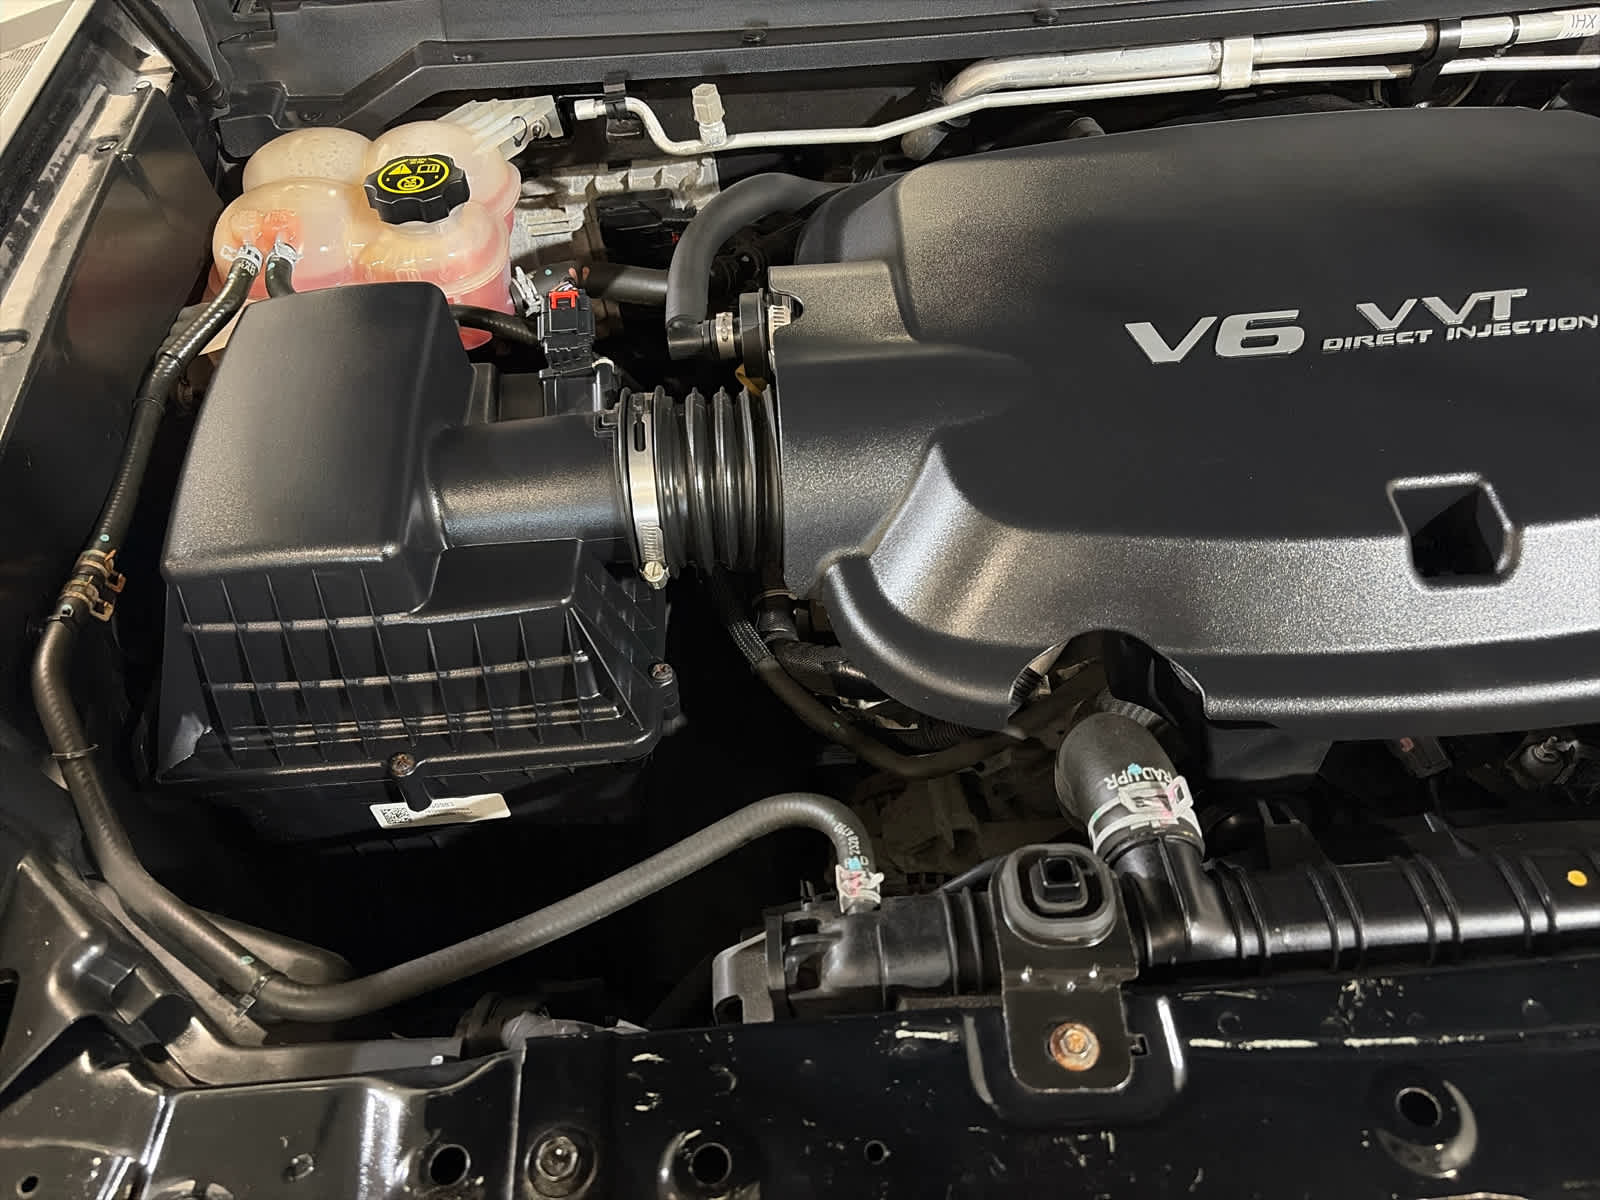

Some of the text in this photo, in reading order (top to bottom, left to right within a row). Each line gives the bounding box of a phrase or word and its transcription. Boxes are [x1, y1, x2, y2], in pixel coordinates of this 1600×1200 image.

[1356, 288, 1528, 331] VVT
[1125, 309, 1305, 364] V6
[1321, 313, 1600, 352] DIRECT INJECTION
